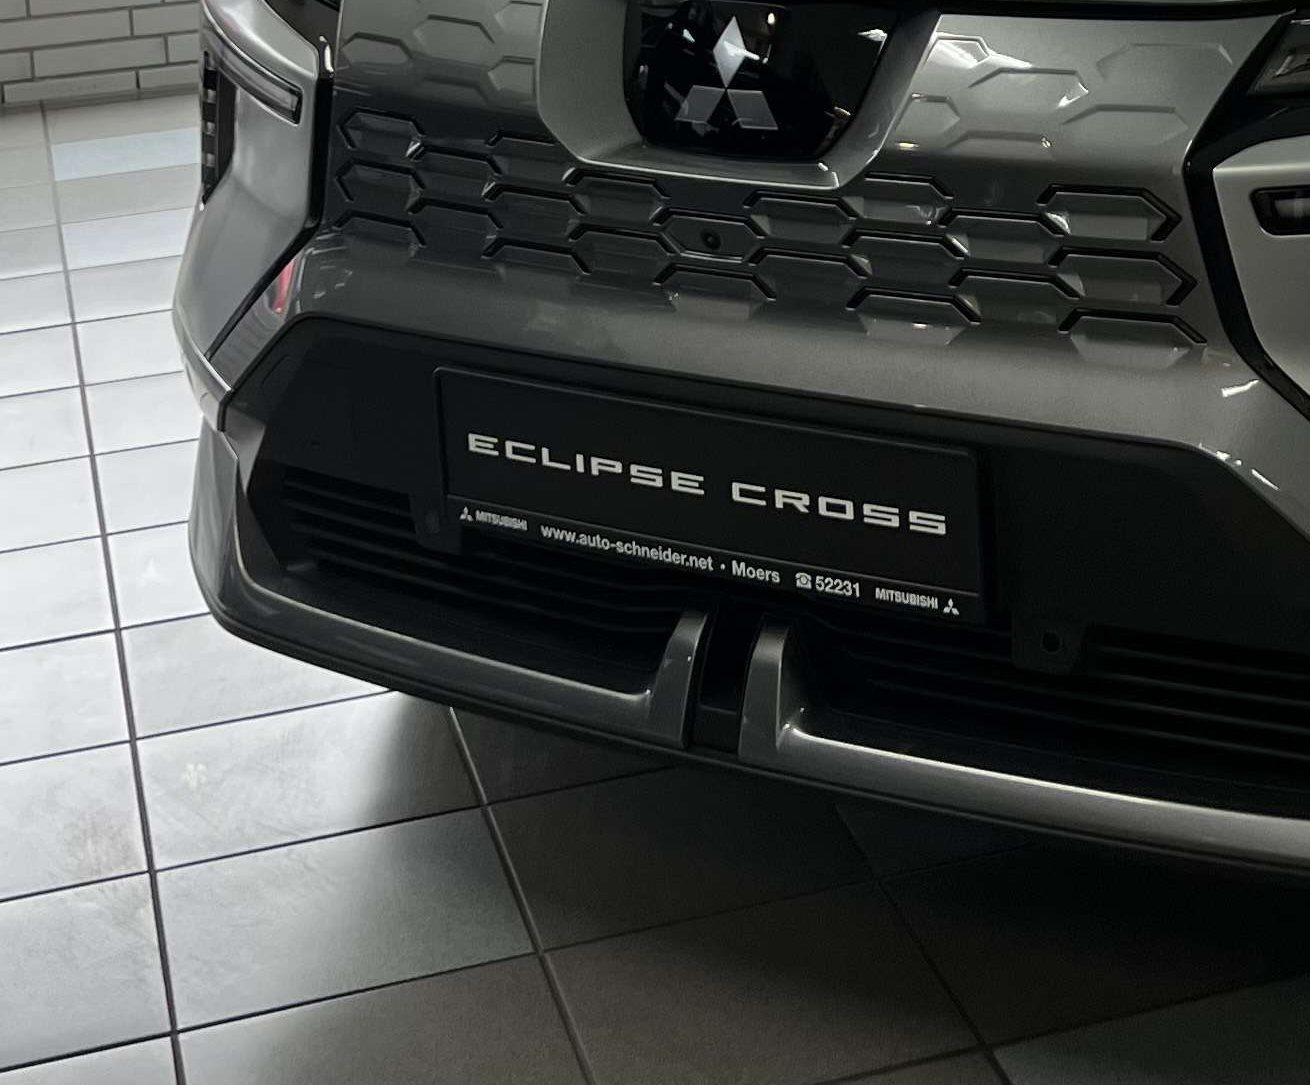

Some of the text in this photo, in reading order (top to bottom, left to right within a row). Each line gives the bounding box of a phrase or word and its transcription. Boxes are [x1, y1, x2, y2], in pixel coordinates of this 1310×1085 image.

[468, 432, 947, 536] ECLIPSE CROSS
[539, 524, 862, 598] www.auto-schneider.net Moers 52231
[874, 586, 940, 610] MITSUBISHI
